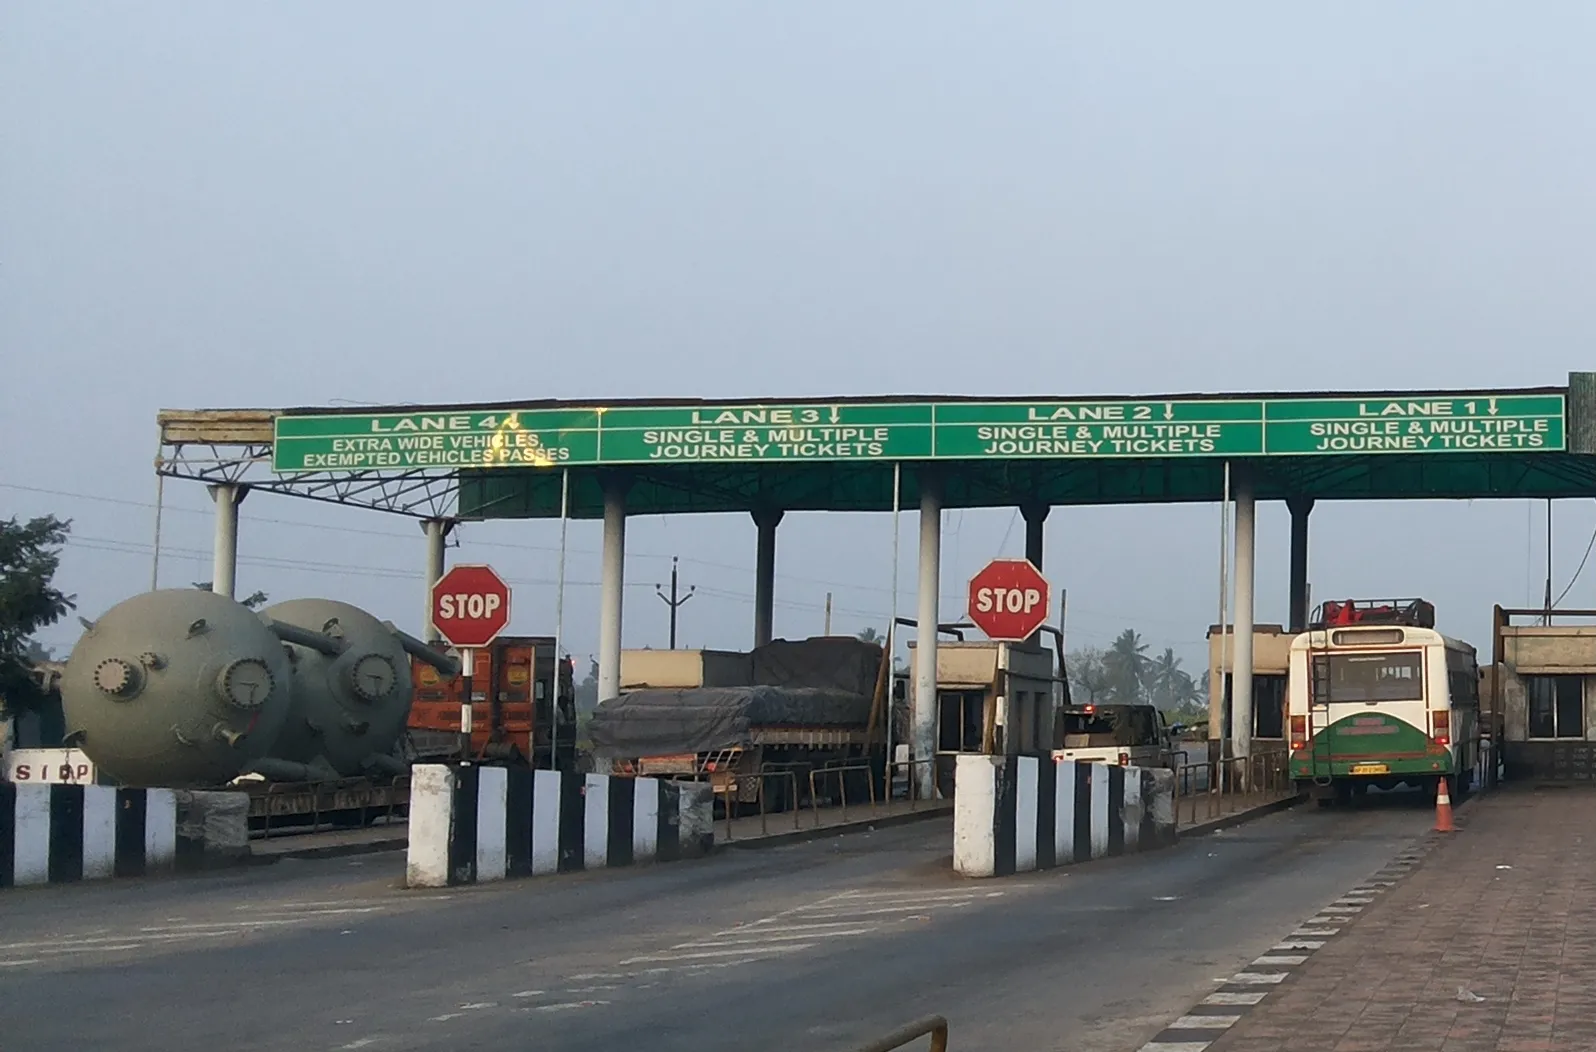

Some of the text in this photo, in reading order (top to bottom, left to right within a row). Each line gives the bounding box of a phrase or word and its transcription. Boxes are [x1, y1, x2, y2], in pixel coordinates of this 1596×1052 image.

[691, 410, 819, 425] LANE 3
[1028, 406, 1152, 421] LANE 2
[1359, 402, 1476, 416] LANE 1
[371, 414, 499, 433] LANE 4
[977, 424, 1222, 440] SINGLE & MULTIPLE
[1310, 419, 1549, 436] SINGLE & MULTIPLE
[643, 427, 889, 444] SINGLE & MULTIPLE
[1316, 433, 1543, 450] JOURNEY TICKETS
[332, 437, 392, 453] EXTRA
[398, 436, 444, 451] WIDE
[649, 442, 883, 459] JOURNEY TICKETS
[984, 438, 1216, 454] JOURNEY TICKETS
[303, 447, 570, 468] EXEMPTED VEHICLES PASSES
[439, 593, 500, 619] STOP
[976, 587, 1040, 613] STOP
